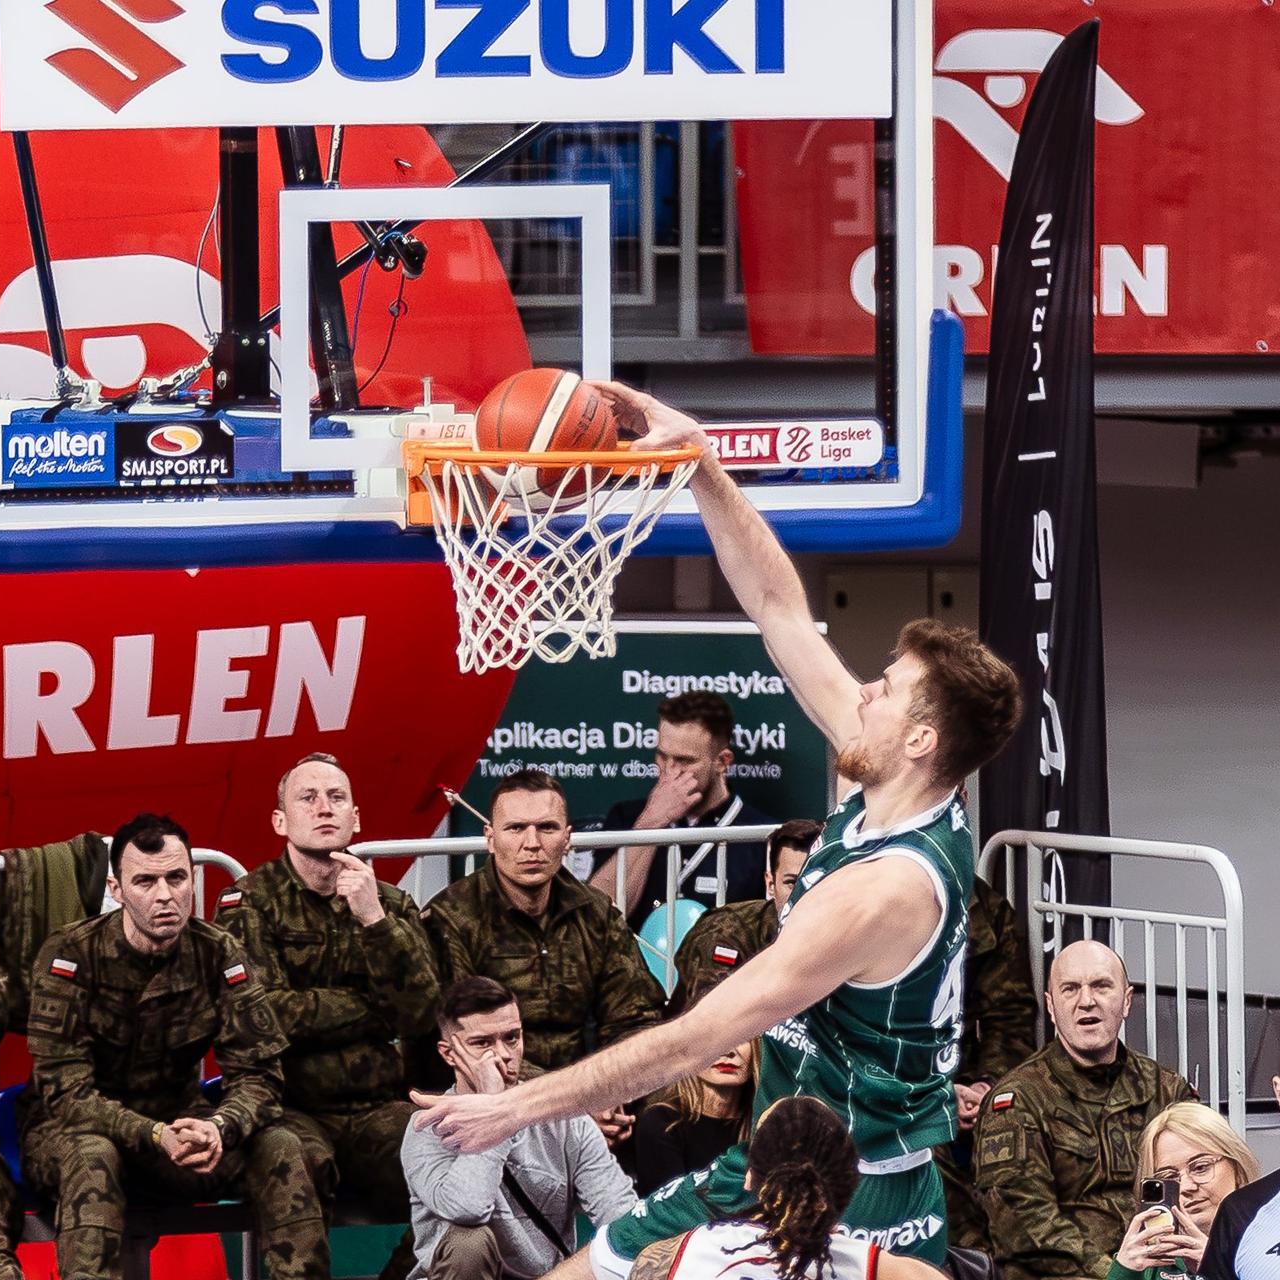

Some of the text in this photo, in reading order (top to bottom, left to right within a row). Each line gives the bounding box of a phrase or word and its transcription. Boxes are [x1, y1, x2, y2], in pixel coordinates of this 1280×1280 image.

[220, 0, 786, 84] SUZUKI
[8, 430, 106, 459] molten
[821, 427, 872, 442] Basket
[821, 444, 852, 462] Liga
[122, 459, 228, 476] SMJSPORT.PL
[622, 670, 786, 698] Diagnostyka
[486, 722, 606, 754] plikacja
